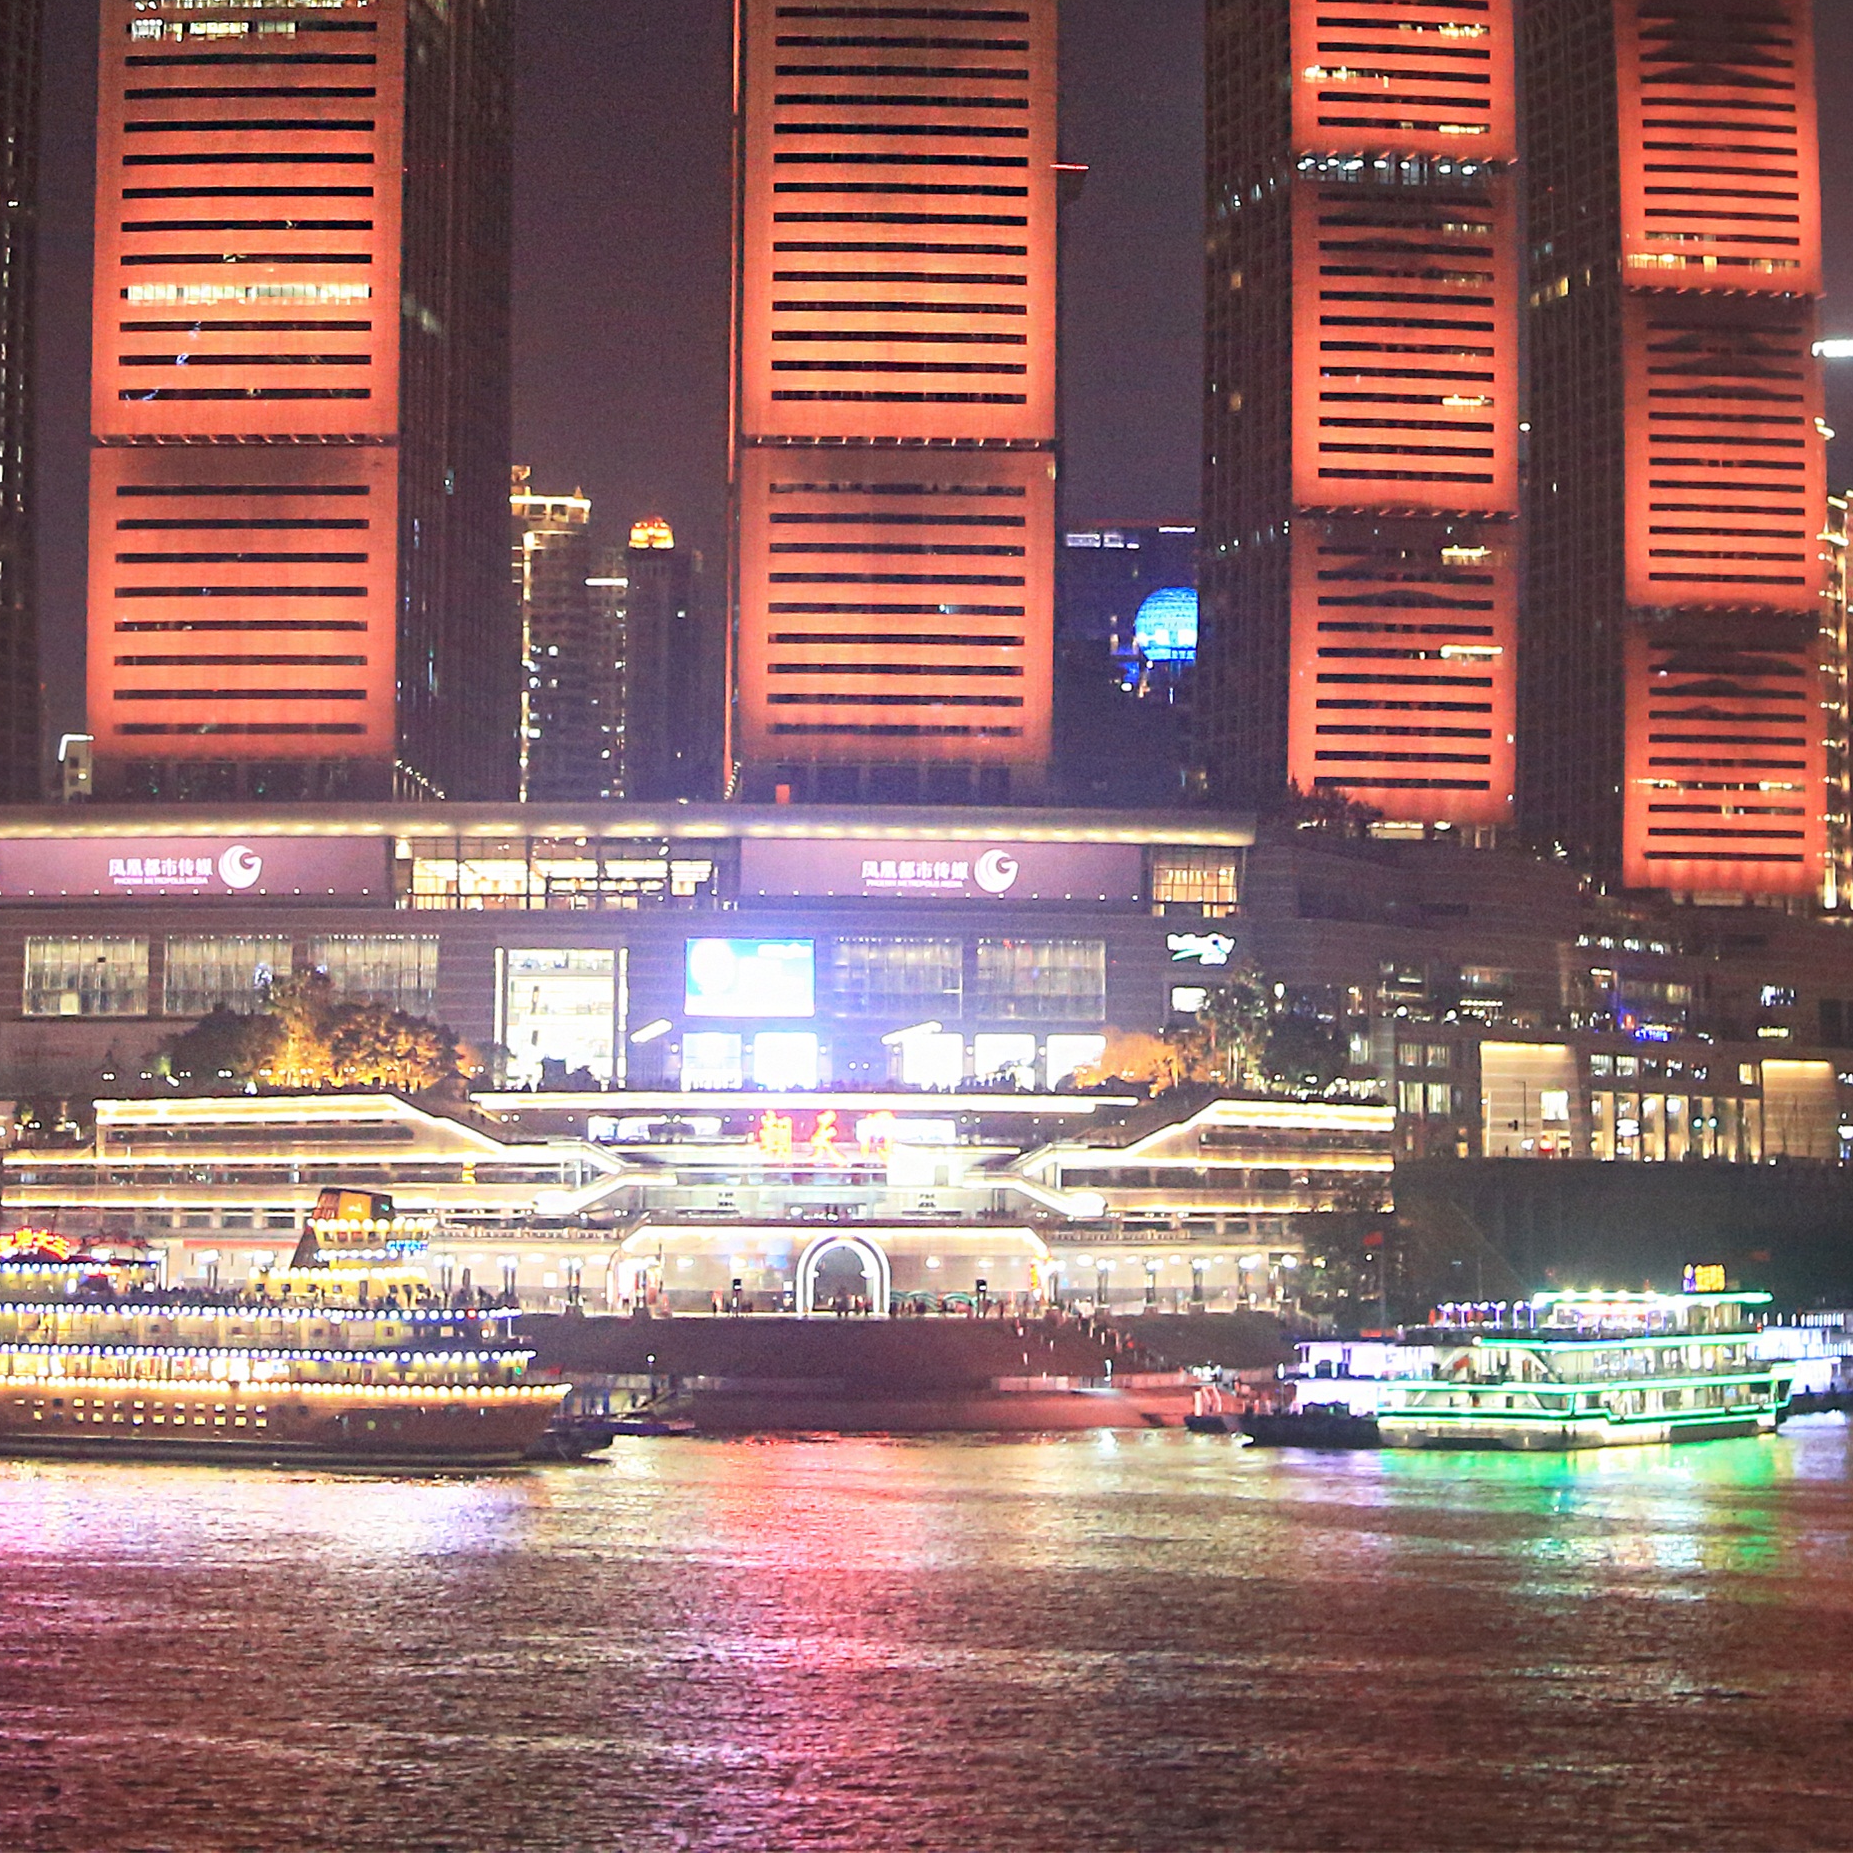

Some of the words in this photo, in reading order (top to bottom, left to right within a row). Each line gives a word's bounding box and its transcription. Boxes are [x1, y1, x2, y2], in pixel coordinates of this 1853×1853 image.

[108, 857, 214, 877] 凤凰都市传媒
[861, 860, 969, 880] 凤凰都市传媒
